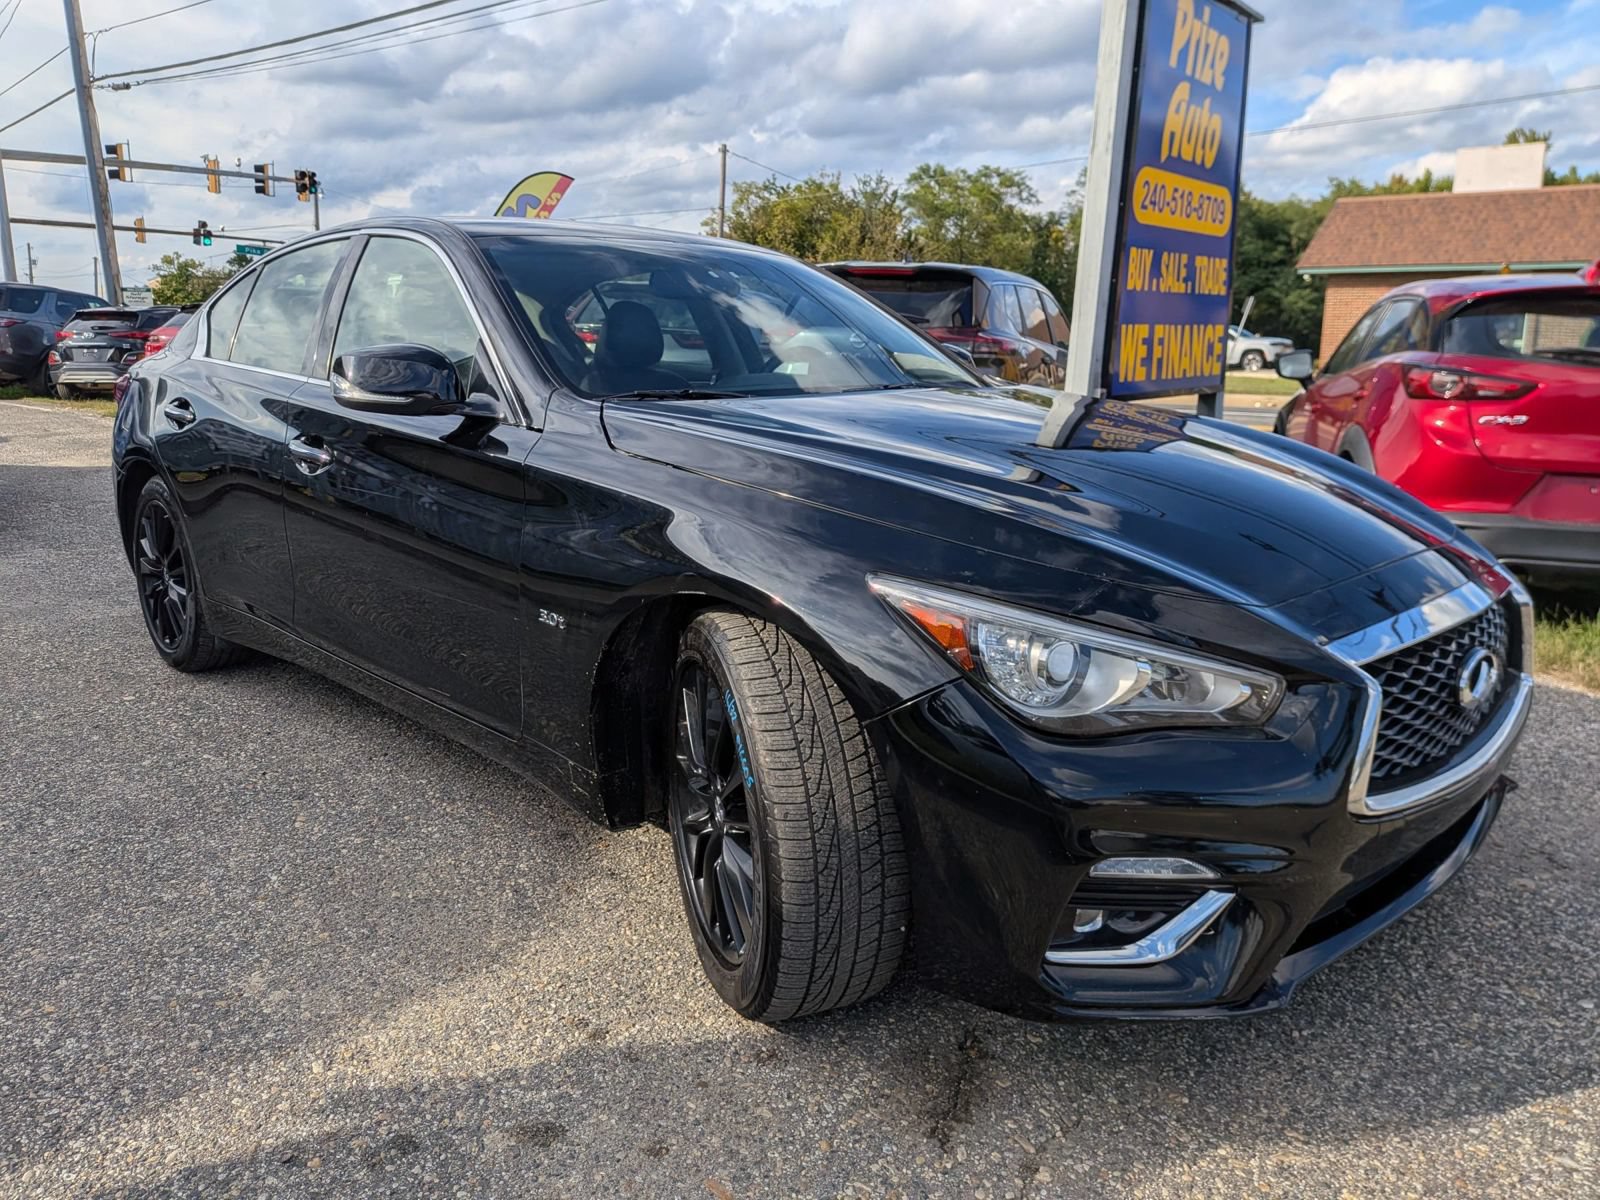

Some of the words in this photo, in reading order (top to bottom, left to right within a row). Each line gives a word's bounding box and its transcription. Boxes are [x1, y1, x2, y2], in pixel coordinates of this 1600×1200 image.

[1169, 0, 1230, 92] Prize
[1160, 80, 1222, 169] Auto
[1139, 180, 1226, 225] 240-518-8709
[1195, 255, 1228, 296] TRADE
[1119, 324, 1150, 383] WE
[1151, 324, 1225, 380] FINANCE
